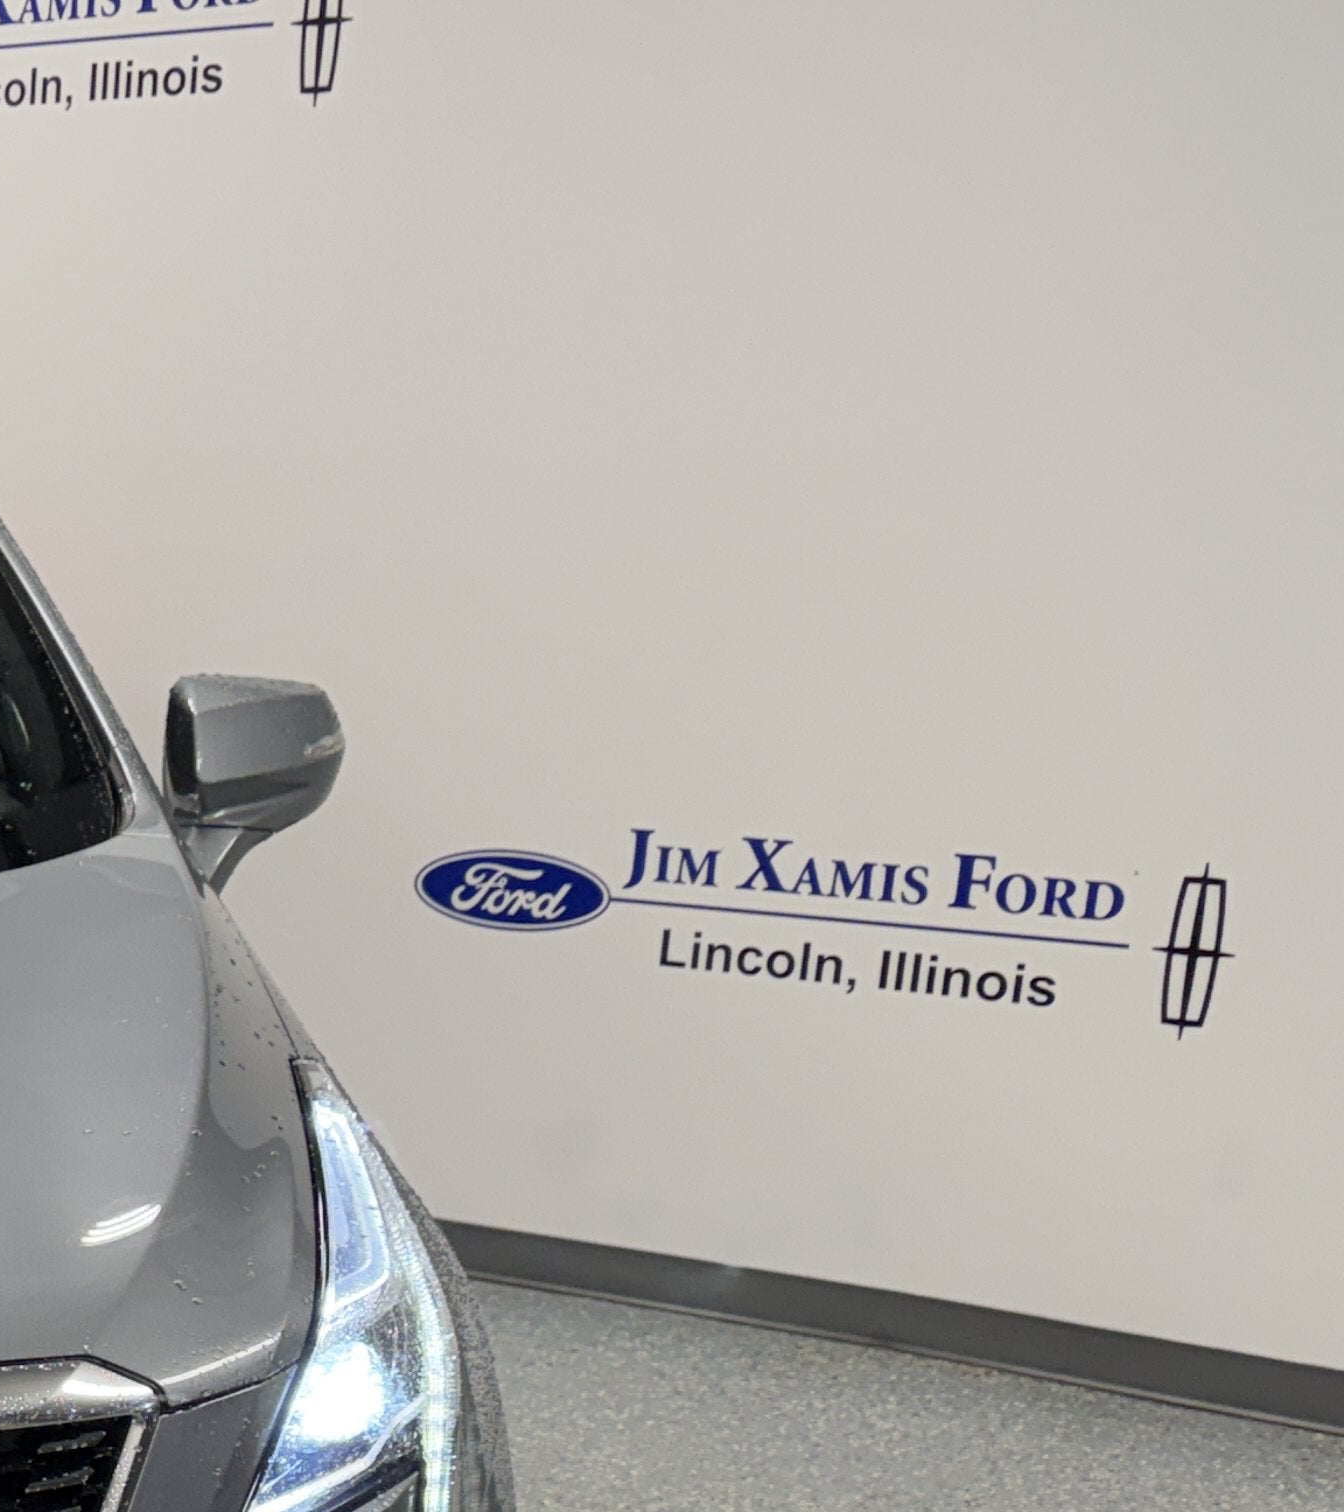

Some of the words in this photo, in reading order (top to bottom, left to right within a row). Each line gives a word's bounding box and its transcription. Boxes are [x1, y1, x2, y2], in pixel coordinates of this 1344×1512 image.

[88, 55, 224, 101] Illinois
[449, 861, 568, 921] Ford
[622, 828, 721, 891] JIM
[736, 837, 930, 907] XAMIS
[947, 852, 1126, 922] FORD
[658, 927, 858, 995] Lincoln,
[877, 950, 1058, 1008] Illinois
